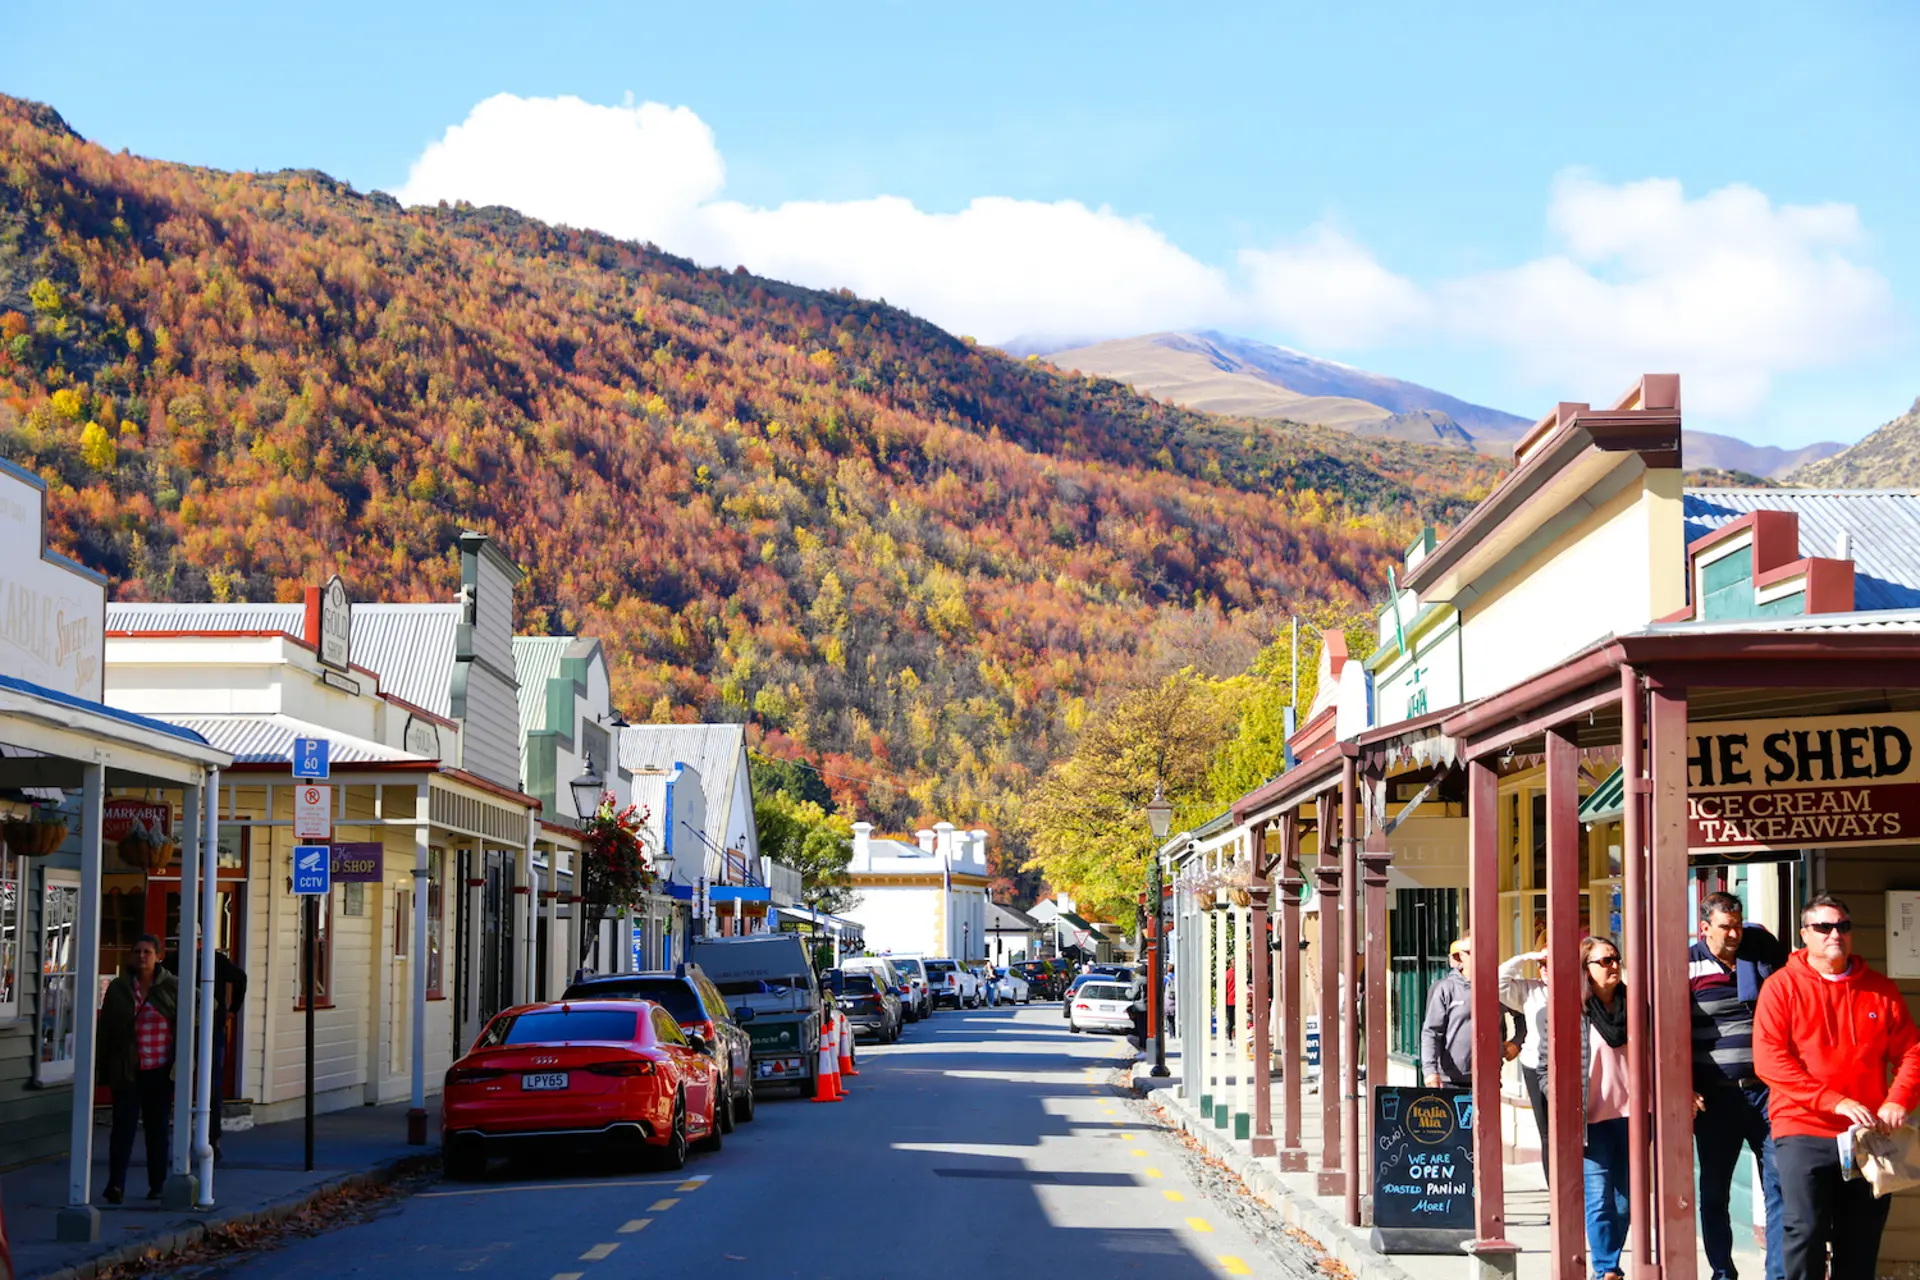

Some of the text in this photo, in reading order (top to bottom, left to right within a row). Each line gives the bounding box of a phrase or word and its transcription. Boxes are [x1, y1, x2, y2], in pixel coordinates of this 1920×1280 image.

[324, 607, 347, 640] GOLD
[306, 741, 318, 755] P
[1687, 725, 1912, 787] HE SHED
[304, 757, 318, 769] 60
[1688, 790, 1872, 820] ICE CREAM
[103, 807, 166, 820] MARKABLE
[1700, 813, 1901, 843] TAKEAWAYS
[343, 861, 376, 873] SHOP
[300, 876, 323, 888] CCTV
[527, 1075, 563, 1088] LPY65
[1413, 1105, 1447, 1119] Italia
[1419, 1117, 1442, 1128] Mia
[1408, 1153, 1450, 1165] WE ARE
[1409, 1165, 1454, 1179] OPEN
